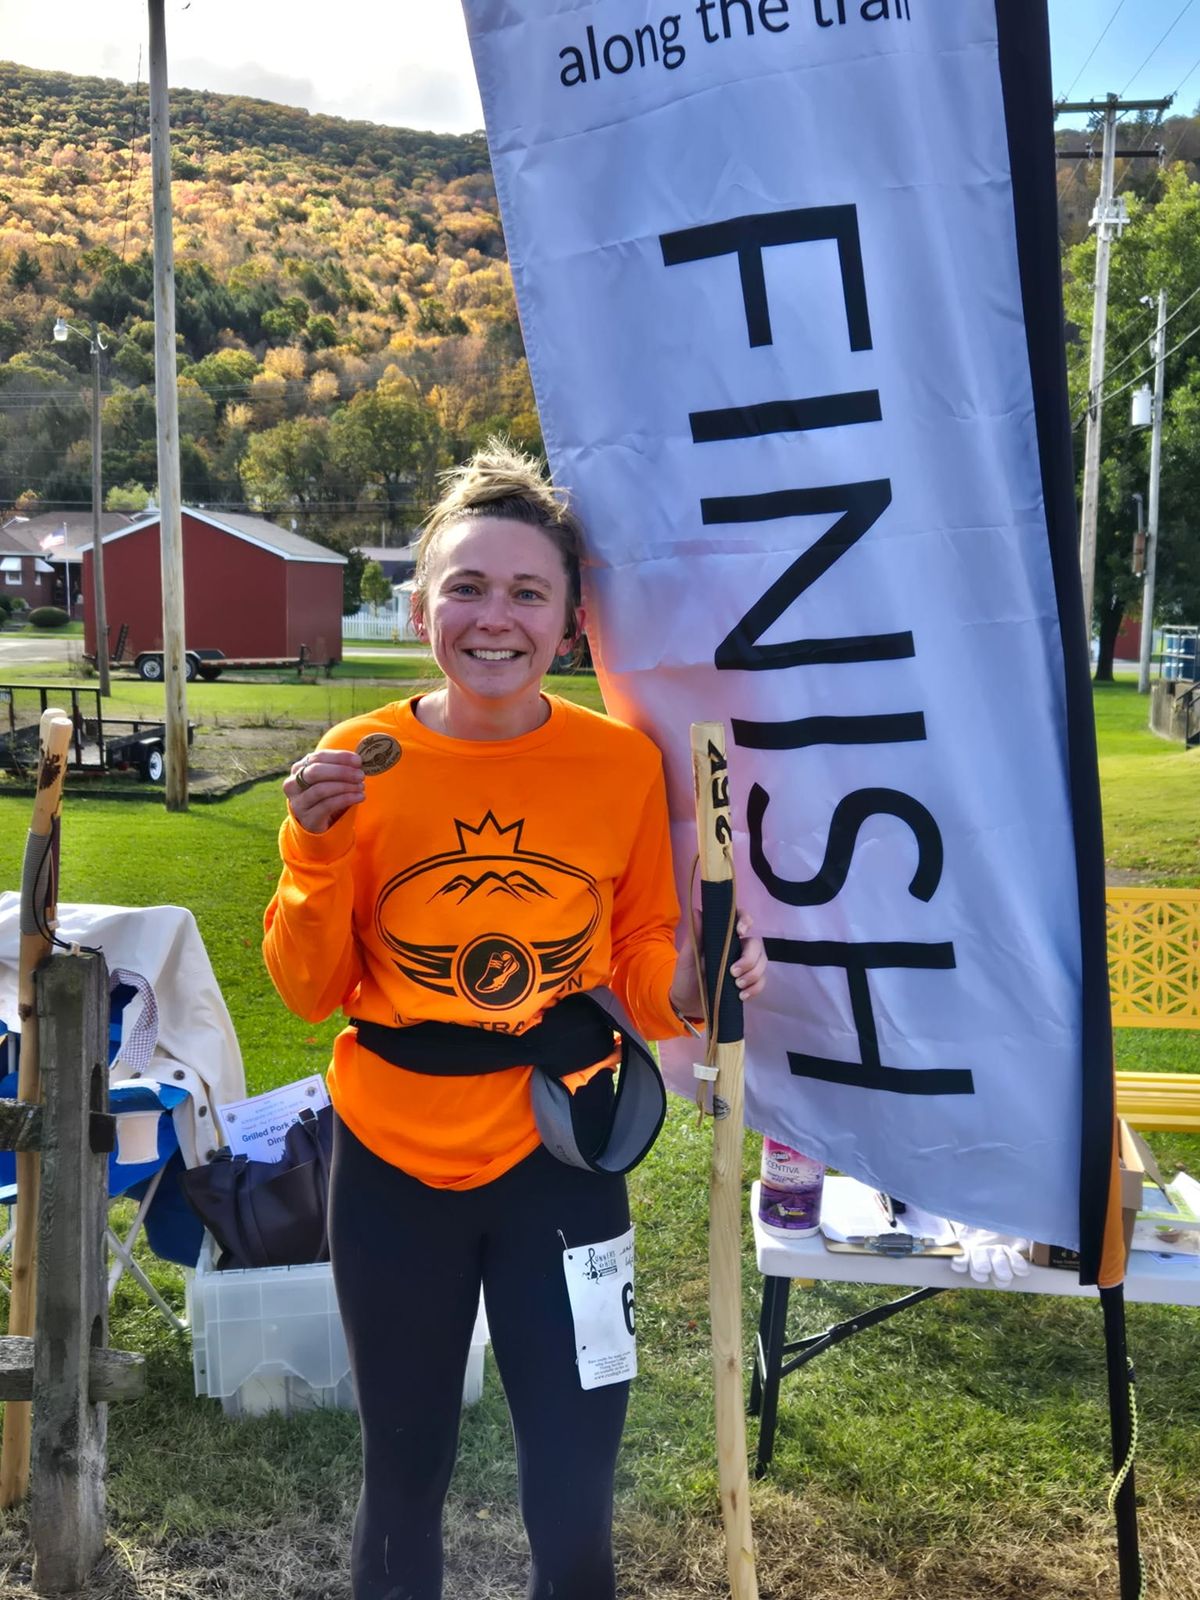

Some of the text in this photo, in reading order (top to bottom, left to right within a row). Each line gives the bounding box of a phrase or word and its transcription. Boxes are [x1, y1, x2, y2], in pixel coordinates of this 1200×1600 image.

[558, 14, 686, 87] along
[695, 0, 790, 43] the
[659, 203, 975, 1097] FINISH
[241, 1122, 290, 1143] Grilled Pork
